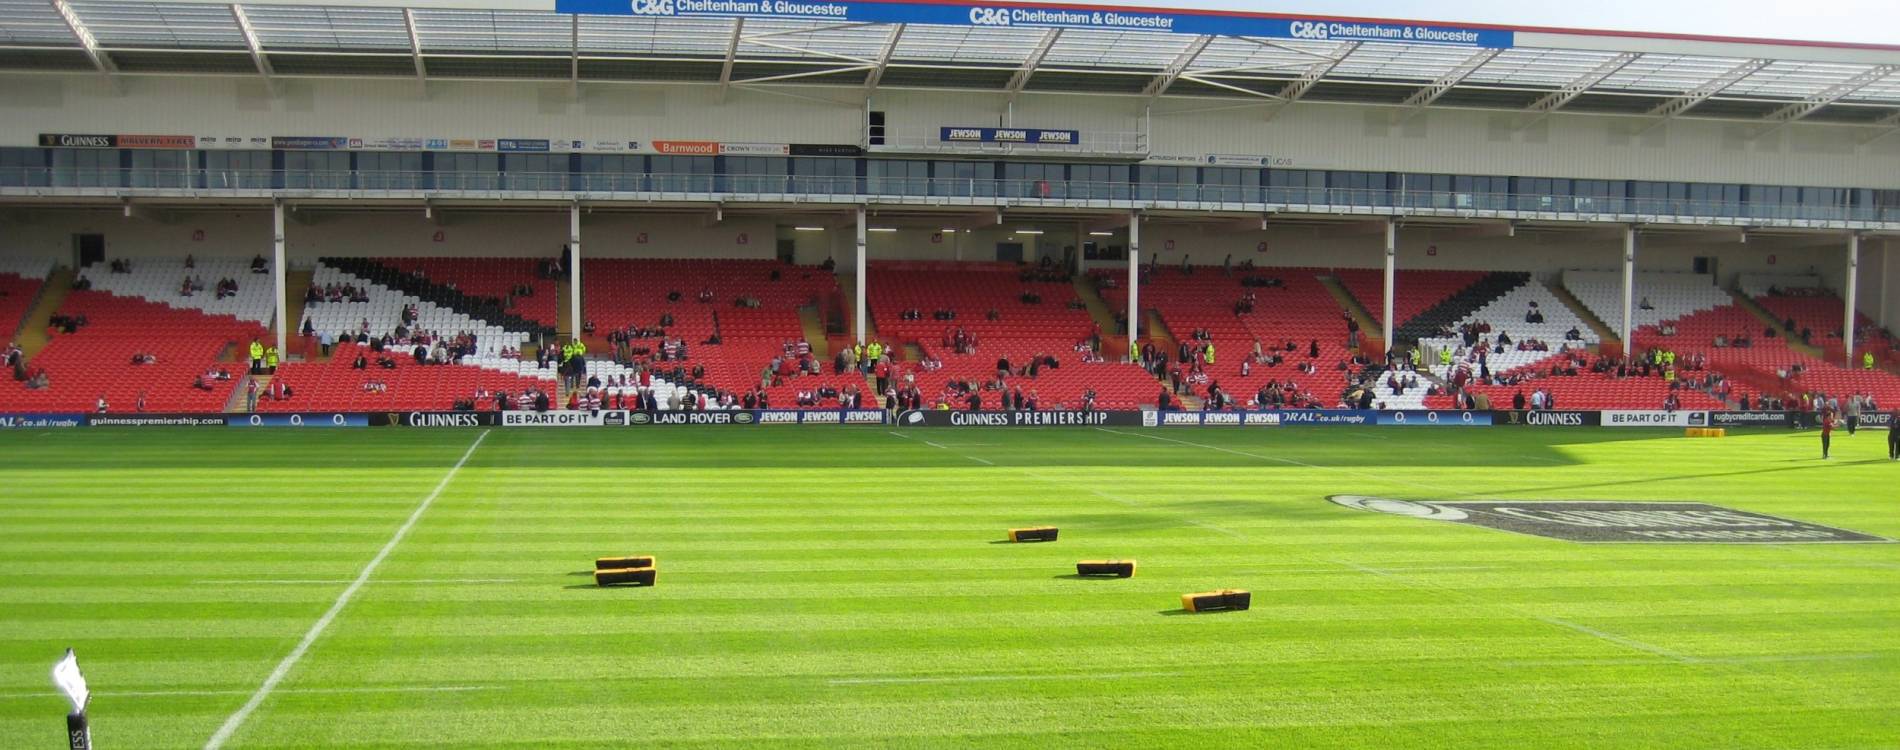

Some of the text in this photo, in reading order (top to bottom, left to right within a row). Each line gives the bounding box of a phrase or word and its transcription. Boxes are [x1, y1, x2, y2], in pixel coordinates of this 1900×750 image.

[631, 0, 848, 16] C&G Cheltenham & Gloucester
[969, 7, 1173, 27] C&G Cheltenham & Gloucester
[1290, 21, 1479, 42] C&G Cheltenham & Gloucester
[949, 129, 982, 139] JEWSON
[994, 130, 1026, 140] JEWSON
[1039, 131, 1071, 141] JEWSON
[61, 134, 110, 147] GUINNESS
[90, 416, 224, 427] guinnesspremiership.com
[409, 412, 479, 427] GUINNESS
[506, 414, 589, 424] BE PART OF IT
[653, 413, 687, 424] LAND
[690, 412, 731, 424] ROVER
[759, 411, 798, 422] JEWSON
[802, 411, 840, 422] JEWSON
[844, 411, 882, 421] JEWSON
[950, 411, 1108, 426] GUINNESS PREMIERSHIP
[1163, 412, 1200, 423] JEWSON
[1204, 412, 1241, 423] JEWSON
[1244, 412, 1280, 423] JEWSON
[1526, 411, 1582, 425] GUINNESS
[1612, 414, 1677, 423] BE PART OF IT
